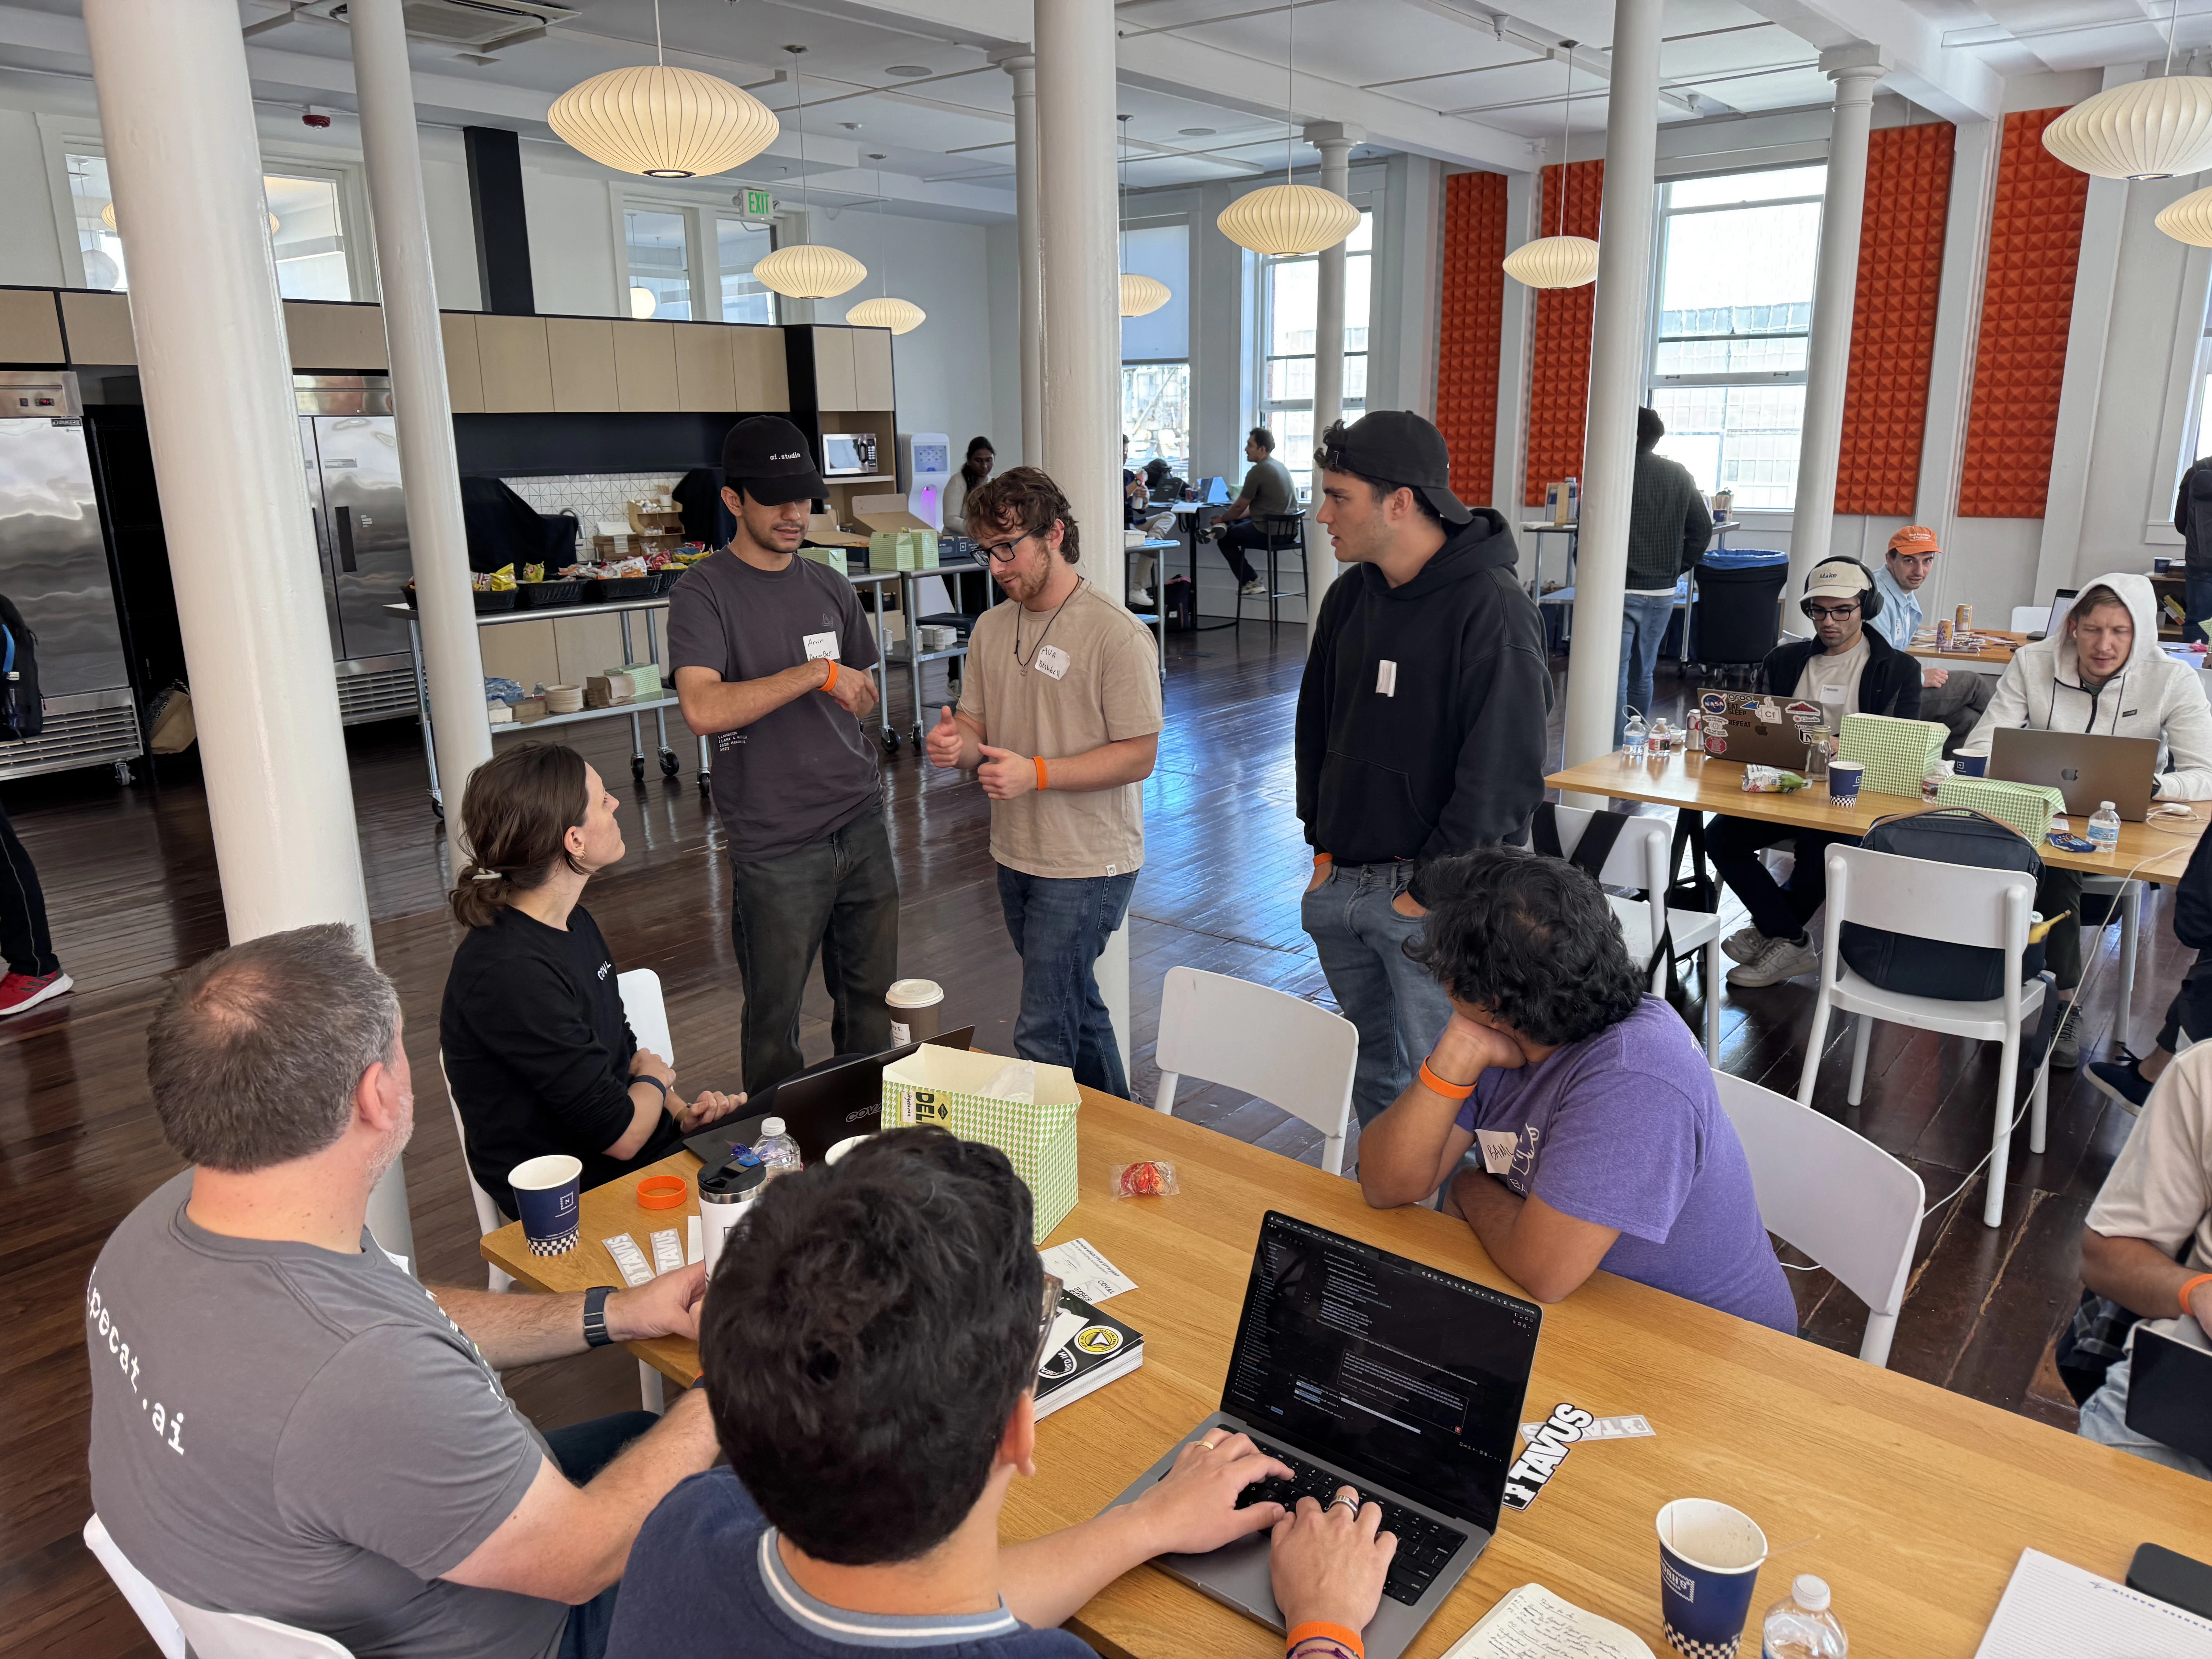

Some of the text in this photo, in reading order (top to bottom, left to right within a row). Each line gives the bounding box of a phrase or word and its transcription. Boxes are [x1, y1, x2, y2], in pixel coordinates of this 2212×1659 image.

[748, 192, 769, 214] EXIT
[770, 452, 801, 460] ai.studio
[916, 1092, 934, 1124] DEL
[607, 1235, 645, 1274] TAVUS
[654, 1230, 680, 1271] TAVUS
[1510, 1403, 1594, 1485] TAVUS
